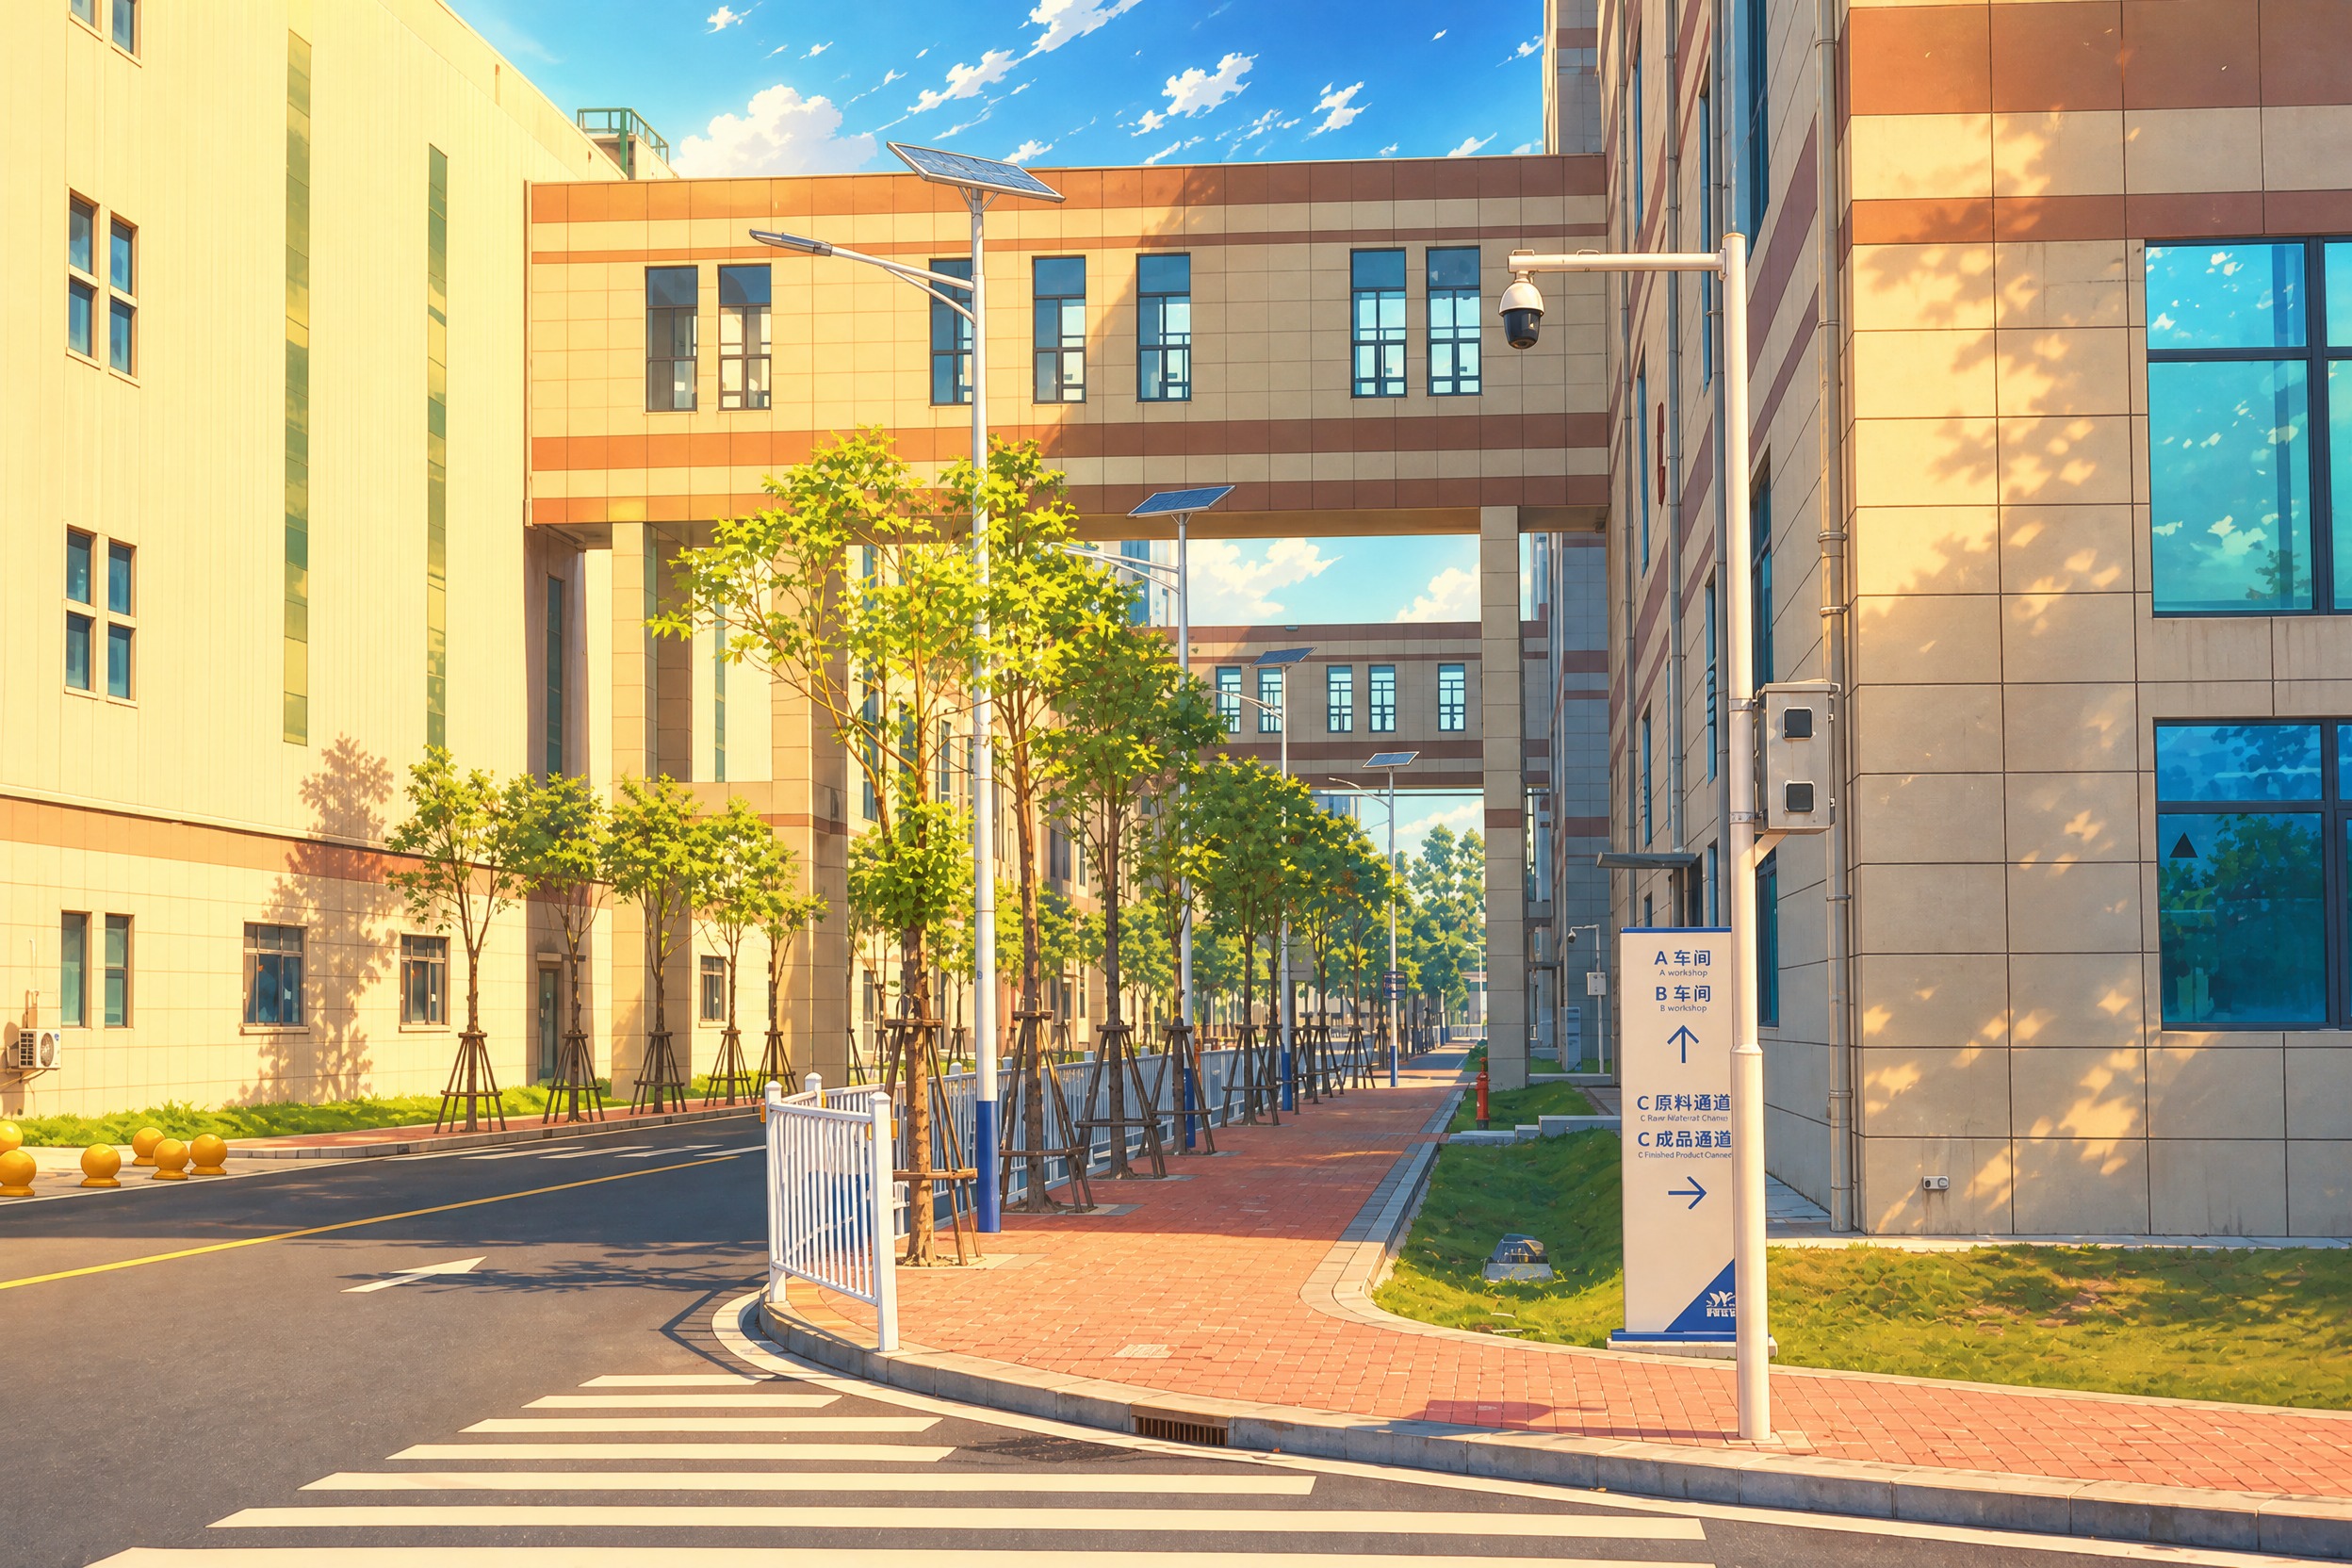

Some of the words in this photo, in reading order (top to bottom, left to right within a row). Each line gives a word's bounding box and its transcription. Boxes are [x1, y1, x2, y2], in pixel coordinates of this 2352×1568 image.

[1654, 950, 1668, 966] A
[1674, 949, 1711, 967] 车间
[1668, 969, 1708, 978] workshop
[1656, 986, 1668, 1001] B
[1674, 985, 1711, 1003] 车间
[1667, 1004, 1707, 1013] workshop
[1637, 1095, 1650, 1111] C
[1655, 1093, 1731, 1112] 原料通道
[1640, 1114, 1646, 1122] C
[1637, 1132, 1650, 1147] C
[1656, 1130, 1732, 1149] 成品通道
[1675, 1151, 1704, 1159] Product
